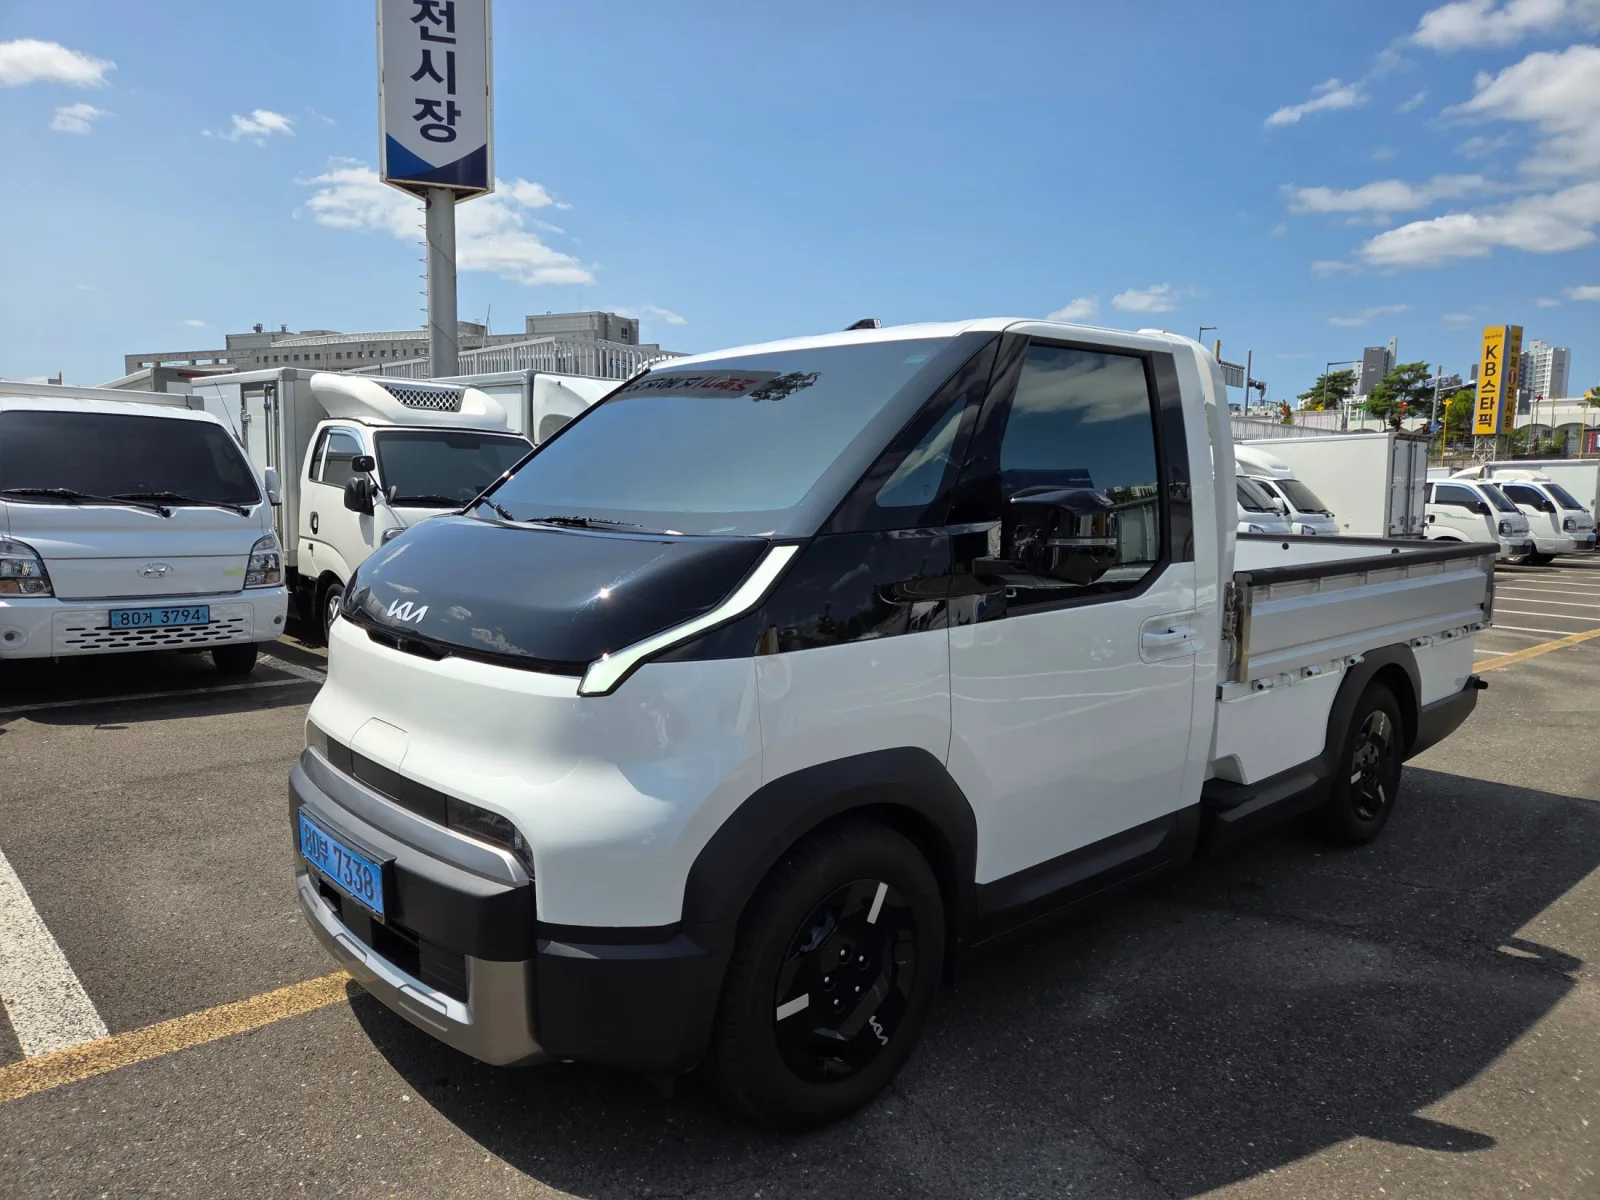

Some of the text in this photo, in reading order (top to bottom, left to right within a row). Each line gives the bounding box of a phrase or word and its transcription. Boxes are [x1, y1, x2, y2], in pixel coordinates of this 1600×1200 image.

[409, 0, 462, 143] 전시장
[1478, 344, 1498, 428] KB스타픽
[120, 609, 201, 626] 80거 3794
[386, 598, 429, 624] KIA
[304, 823, 374, 901] 80부 7338
